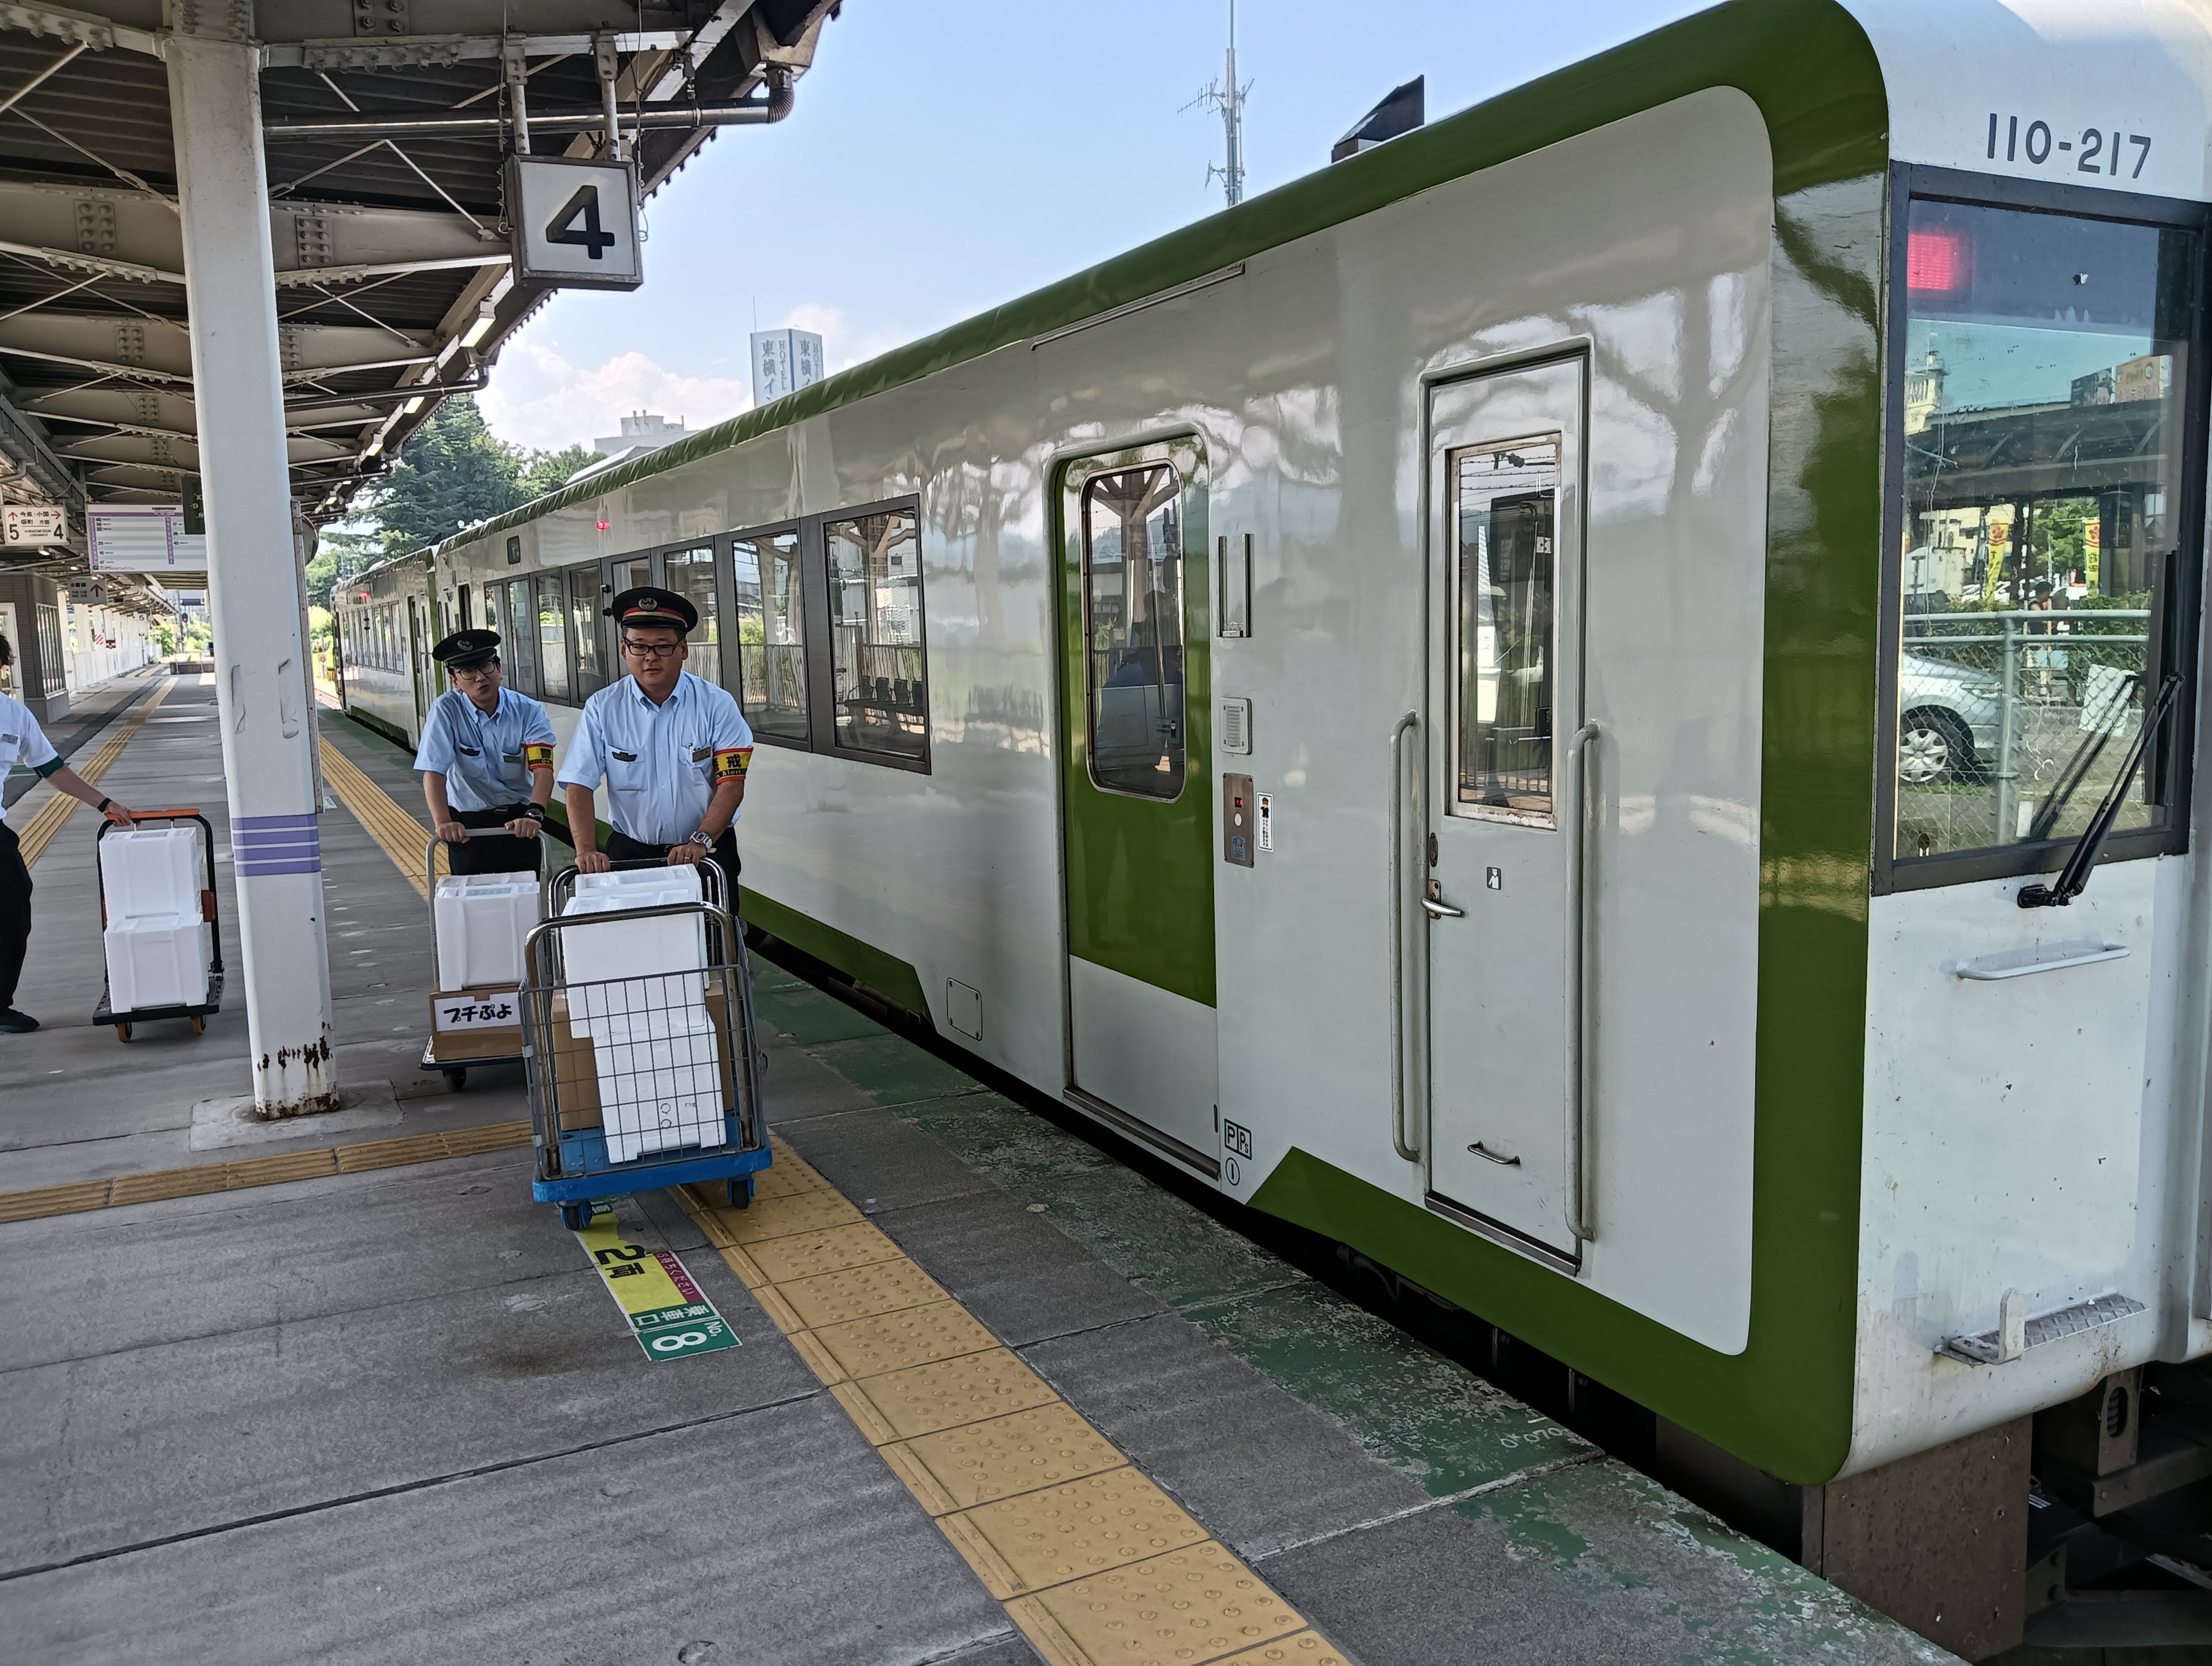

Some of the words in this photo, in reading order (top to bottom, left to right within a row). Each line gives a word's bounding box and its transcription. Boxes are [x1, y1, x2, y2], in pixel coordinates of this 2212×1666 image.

[1986, 113, 2151, 179] 110-217
[545, 184, 615, 260] 4
[761, 339, 777, 400] 東横イ
[778, 339, 787, 390] HOTEL
[9, 524, 20, 540] 5
[54, 523, 64, 540] 4
[443, 1003, 512, 1023] プチぷよ
[634, 1304, 710, 1327] 乗車口
[652, 1331, 707, 1351] 8
